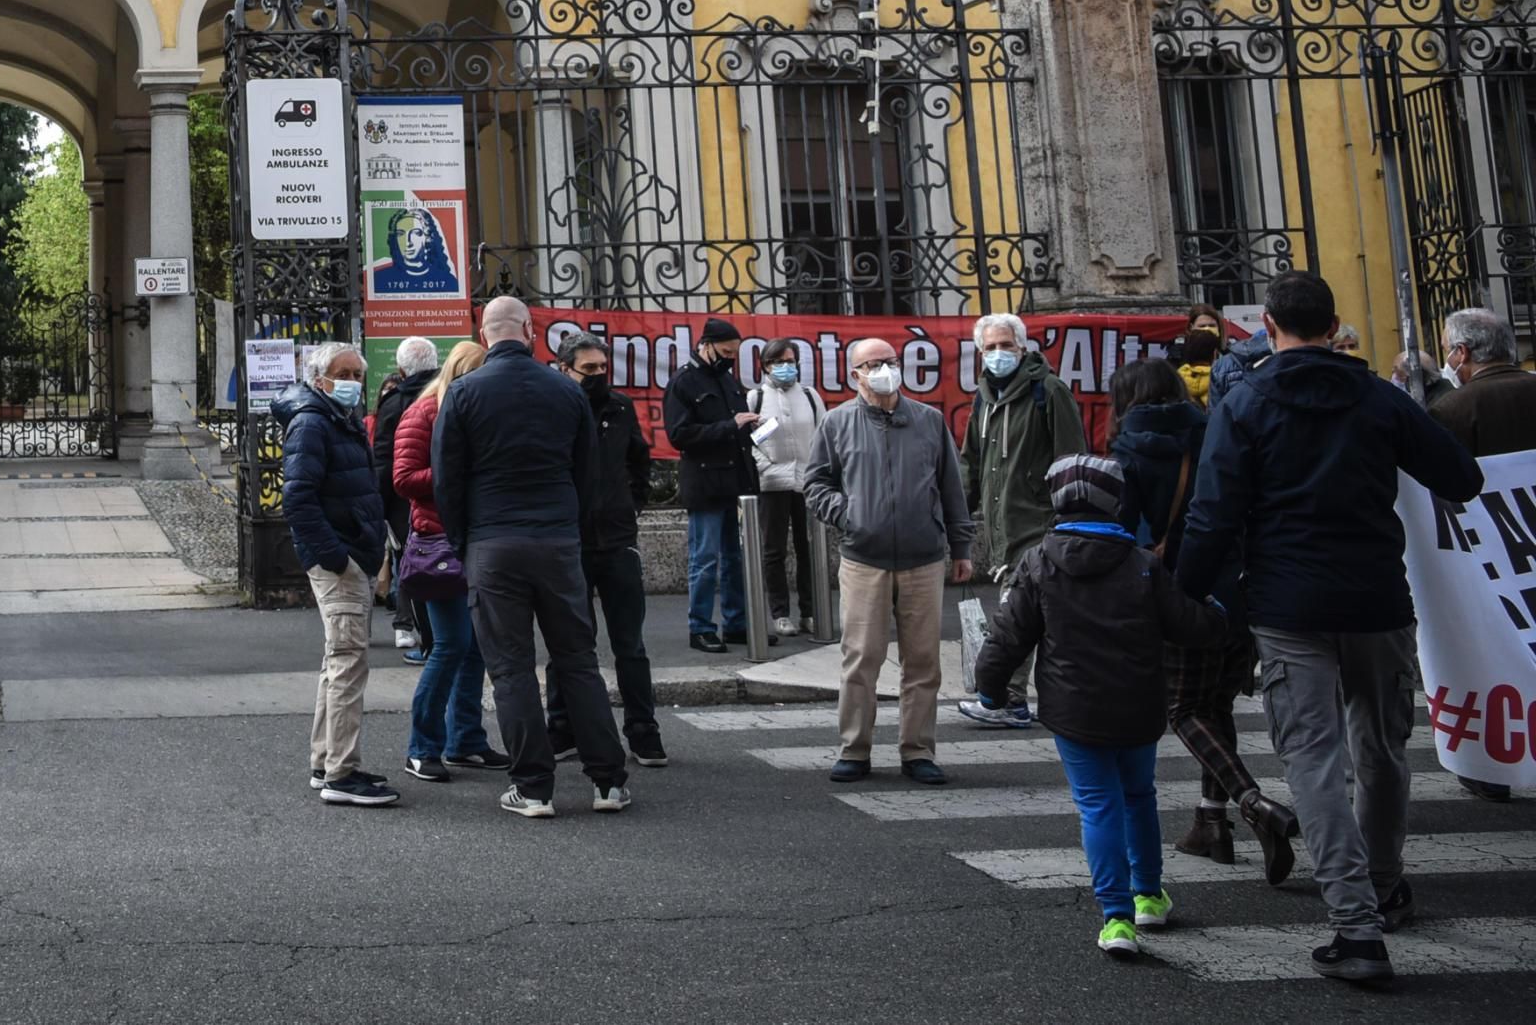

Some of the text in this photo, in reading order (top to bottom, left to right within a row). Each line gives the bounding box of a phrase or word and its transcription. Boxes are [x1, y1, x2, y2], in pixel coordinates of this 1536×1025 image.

[272, 148, 323, 157] INGRESSO
[266, 160, 329, 168] AMBULANZE
[281, 183, 315, 192] NUOVI
[276, 195, 322, 204] RICOVERI
[421, 199, 456, 207] Trivulzio
[258, 216, 342, 226] VIA TRIVULZIO 15
[138, 267, 185, 275] RALLENTARE
[416, 309, 469, 317] PERMANENTE
[545, 320, 862, 392] Sndcat
[904, 326, 942, 393] è
[1425, 683, 1536, 765] #C
